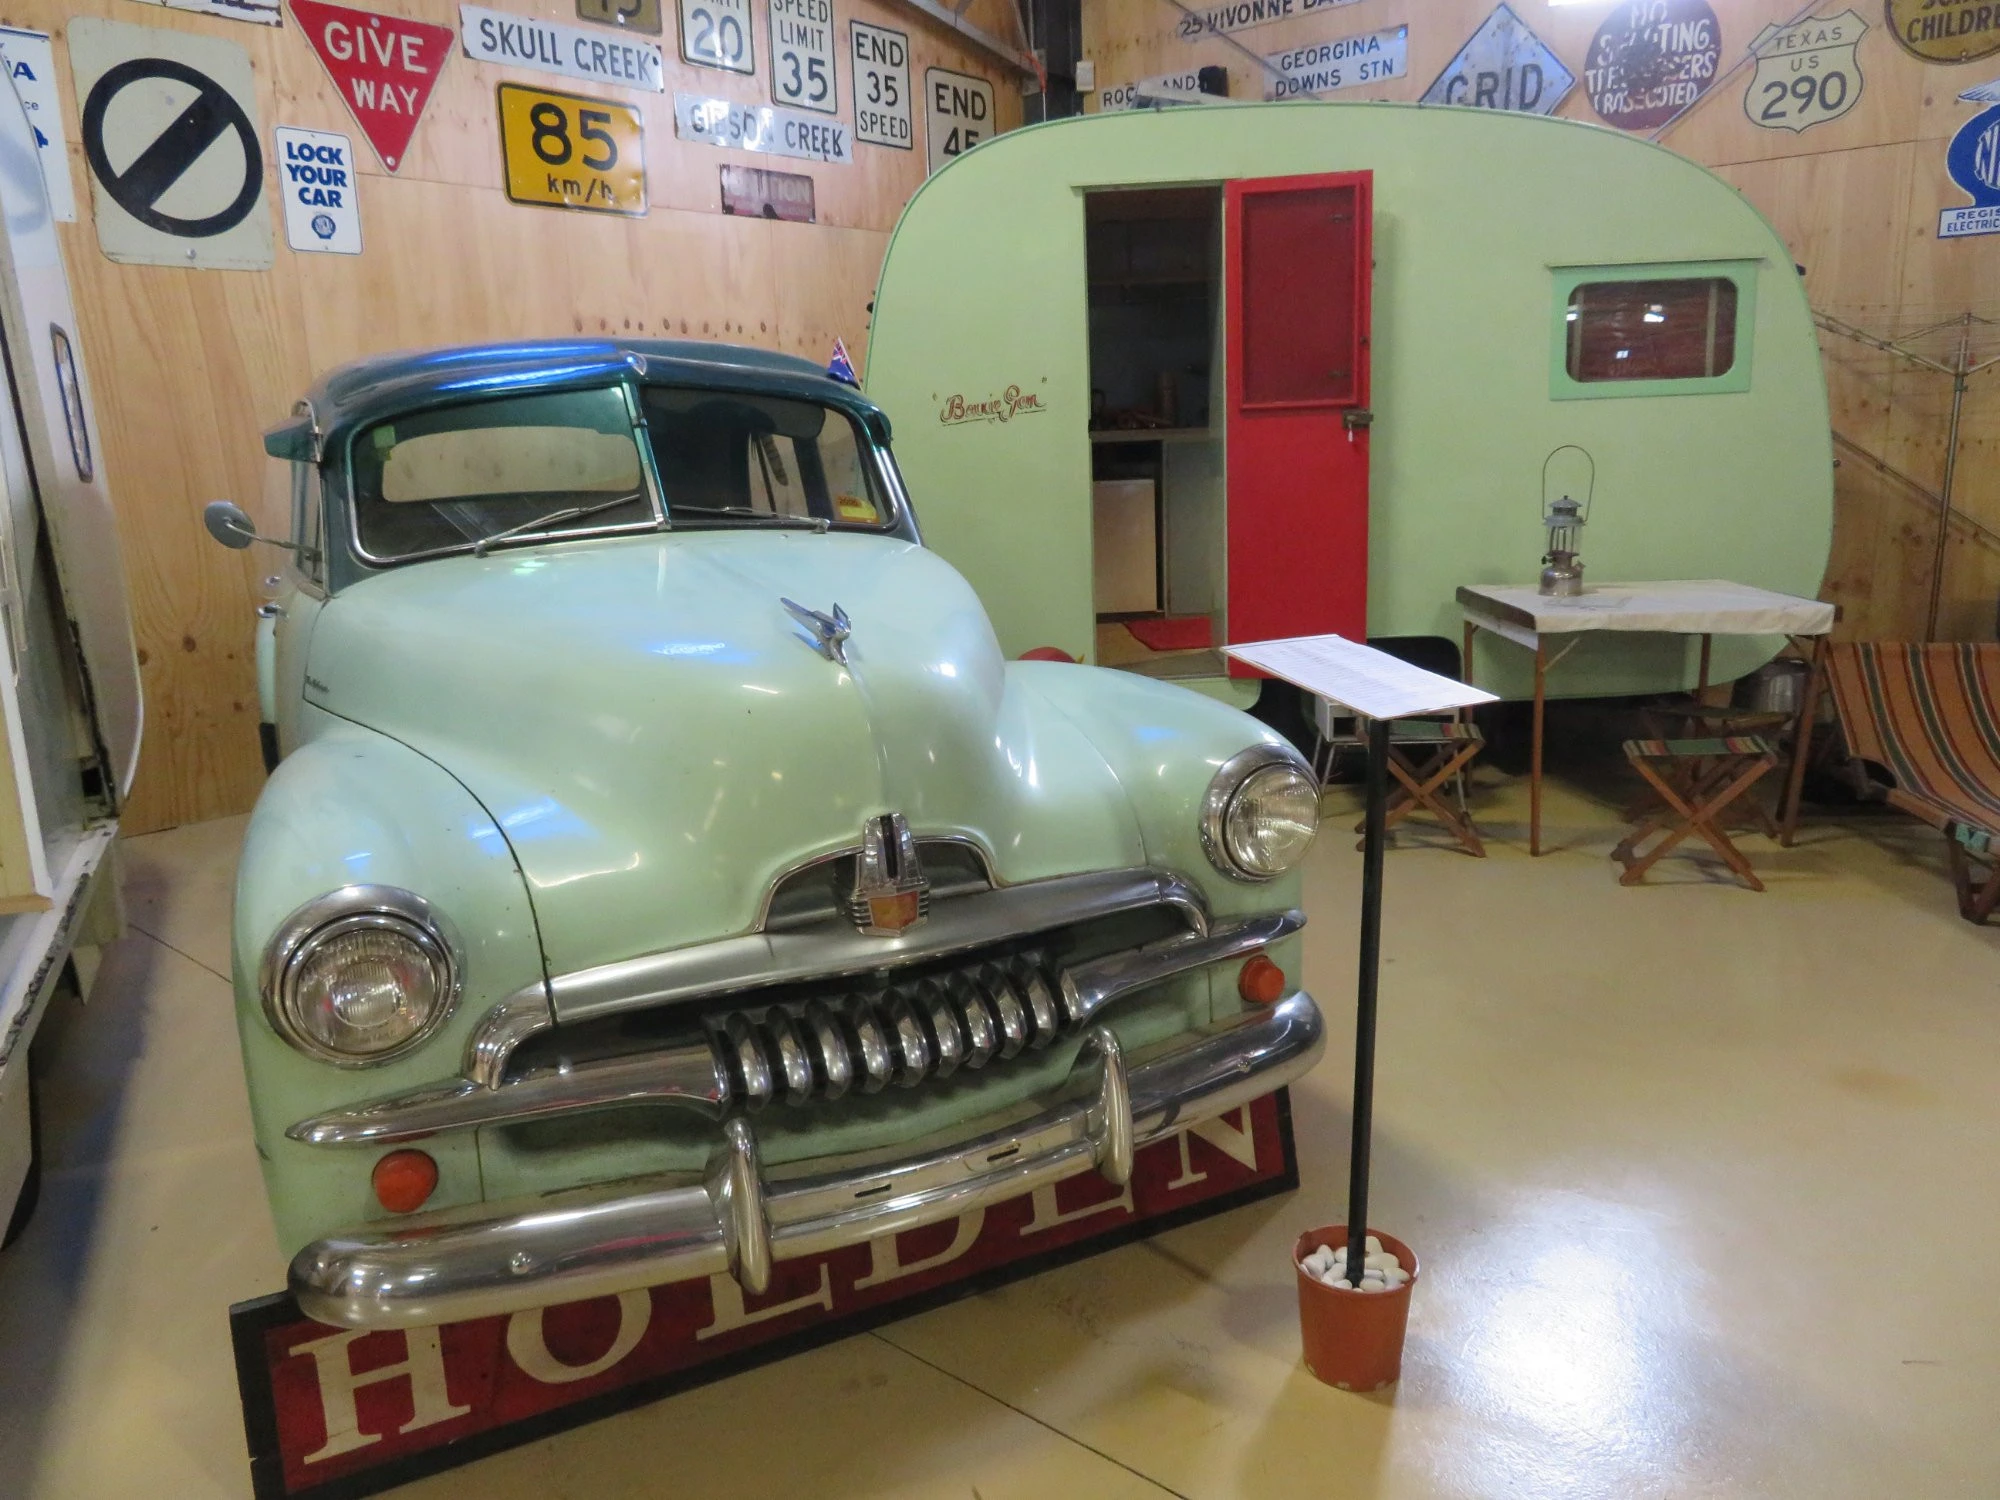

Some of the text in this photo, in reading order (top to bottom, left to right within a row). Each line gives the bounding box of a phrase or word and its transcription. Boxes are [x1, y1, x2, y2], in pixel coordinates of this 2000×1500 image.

[324, 21, 427, 74] GIVE
[480, 18, 650, 81] SKULL CREEK
[691, 8, 743, 62] 20
[779, 20, 824, 52] LIMIT
[856, 32, 904, 68] END
[1281, 35, 1381, 72] GEORGINA
[1775, 26, 1843, 52] TEXAS
[782, 51, 828, 102] 35
[1275, 58, 1393, 97] DOWNS STN
[1791, 55, 1819, 72] US
[352, 77, 419, 116] WAY
[867, 71, 898, 107] 35
[935, 82, 986, 121] END
[1446, 63, 1544, 111] GRID
[1761, 71, 1847, 121] 290
[530, 102, 618, 172] 85
[785, 120, 843, 157] CREEK
[860, 110, 908, 139] SPEED
[286, 141, 344, 166] LOCK
[285, 163, 347, 187] YOUR
[298, 186, 343, 208] CAR
